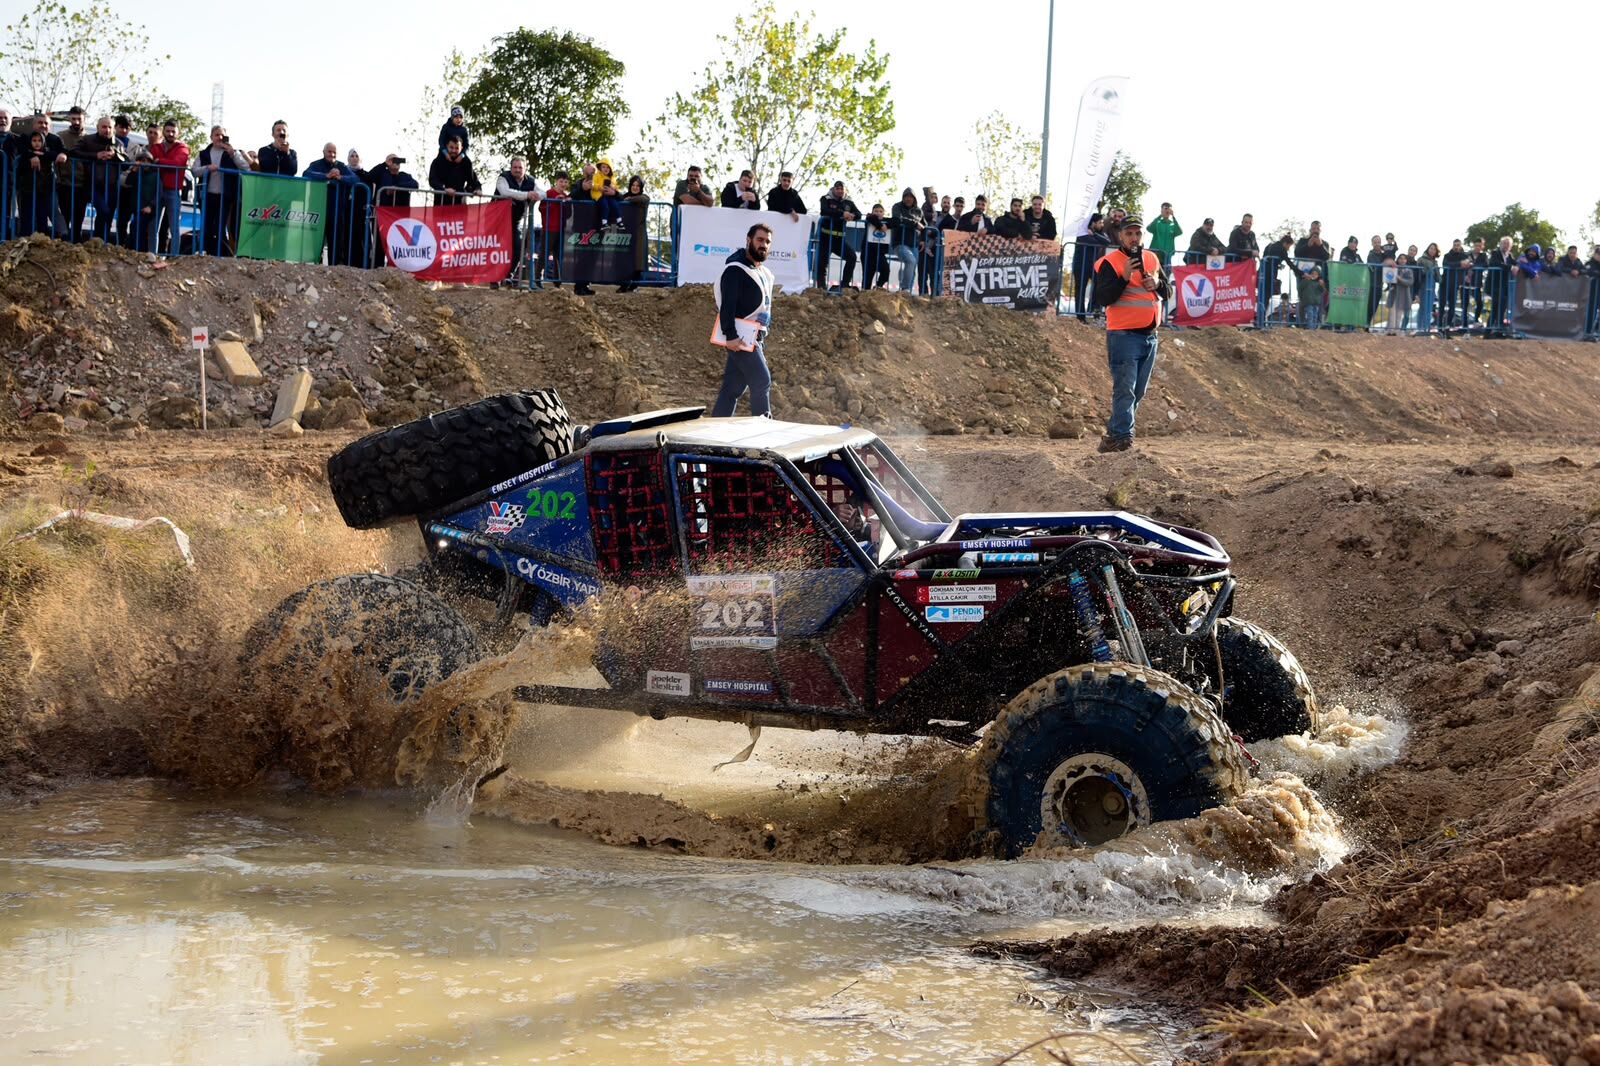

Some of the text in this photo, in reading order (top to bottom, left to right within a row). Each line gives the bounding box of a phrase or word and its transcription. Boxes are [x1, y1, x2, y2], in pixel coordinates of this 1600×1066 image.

[437, 221, 465, 236] THE
[440, 235, 501, 252] ORIGINAL
[392, 246, 432, 260] VALVOLINE
[441, 251, 511, 268] ENGINE OIL
[949, 257, 1049, 304] EXTREME
[1215, 275, 1231, 288] THE
[1215, 285, 1248, 300] ORIGINAL
[1213, 298, 1254, 313] ENGINE OIL
[491, 461, 555, 494] EMSEY HOSPITAL
[527, 489, 576, 518] 202
[986, 553, 1033, 562] KING
[701, 600, 765, 629] 202
[707, 680, 769, 691] EMSEY HOSPITAL
